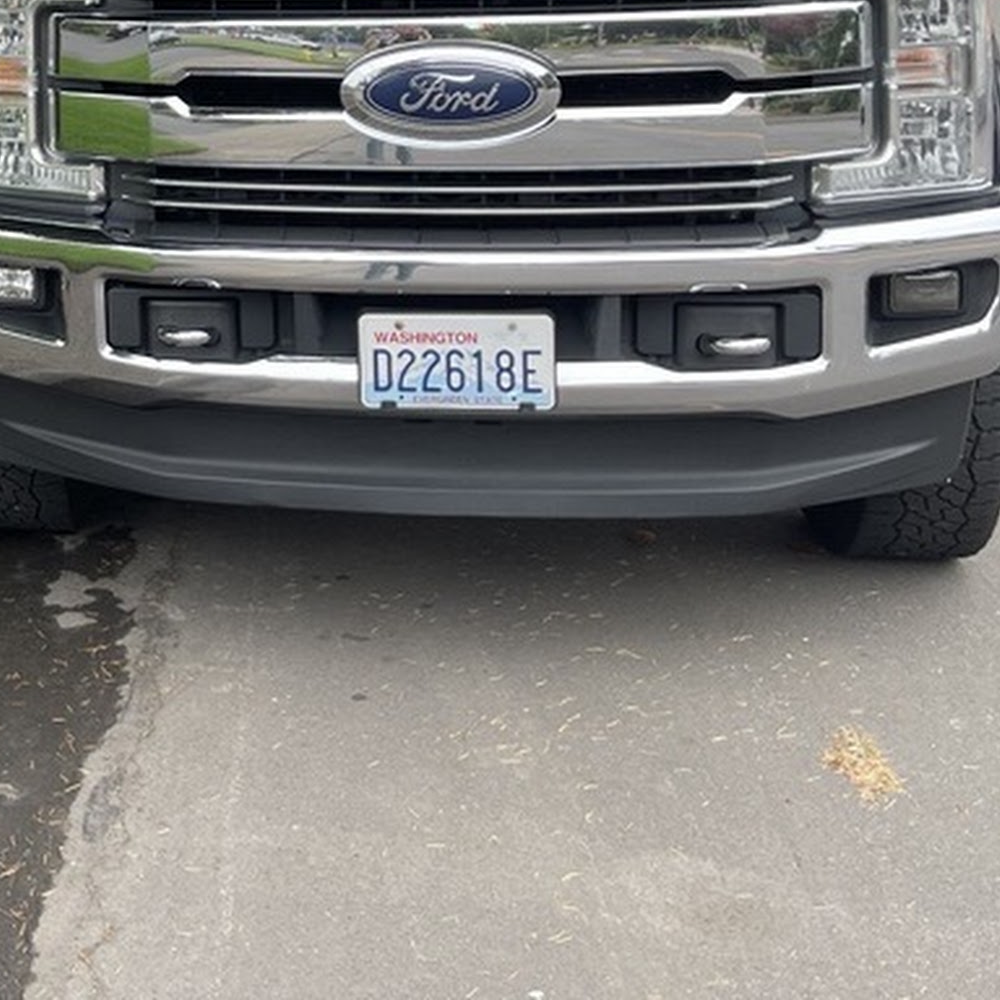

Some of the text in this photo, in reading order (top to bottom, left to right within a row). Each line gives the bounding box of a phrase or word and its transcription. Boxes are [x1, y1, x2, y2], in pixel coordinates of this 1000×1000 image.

[401, 72, 500, 113] Ford
[373, 332, 478, 345] WASHINGTON
[373, 349, 542, 393] D22618E
